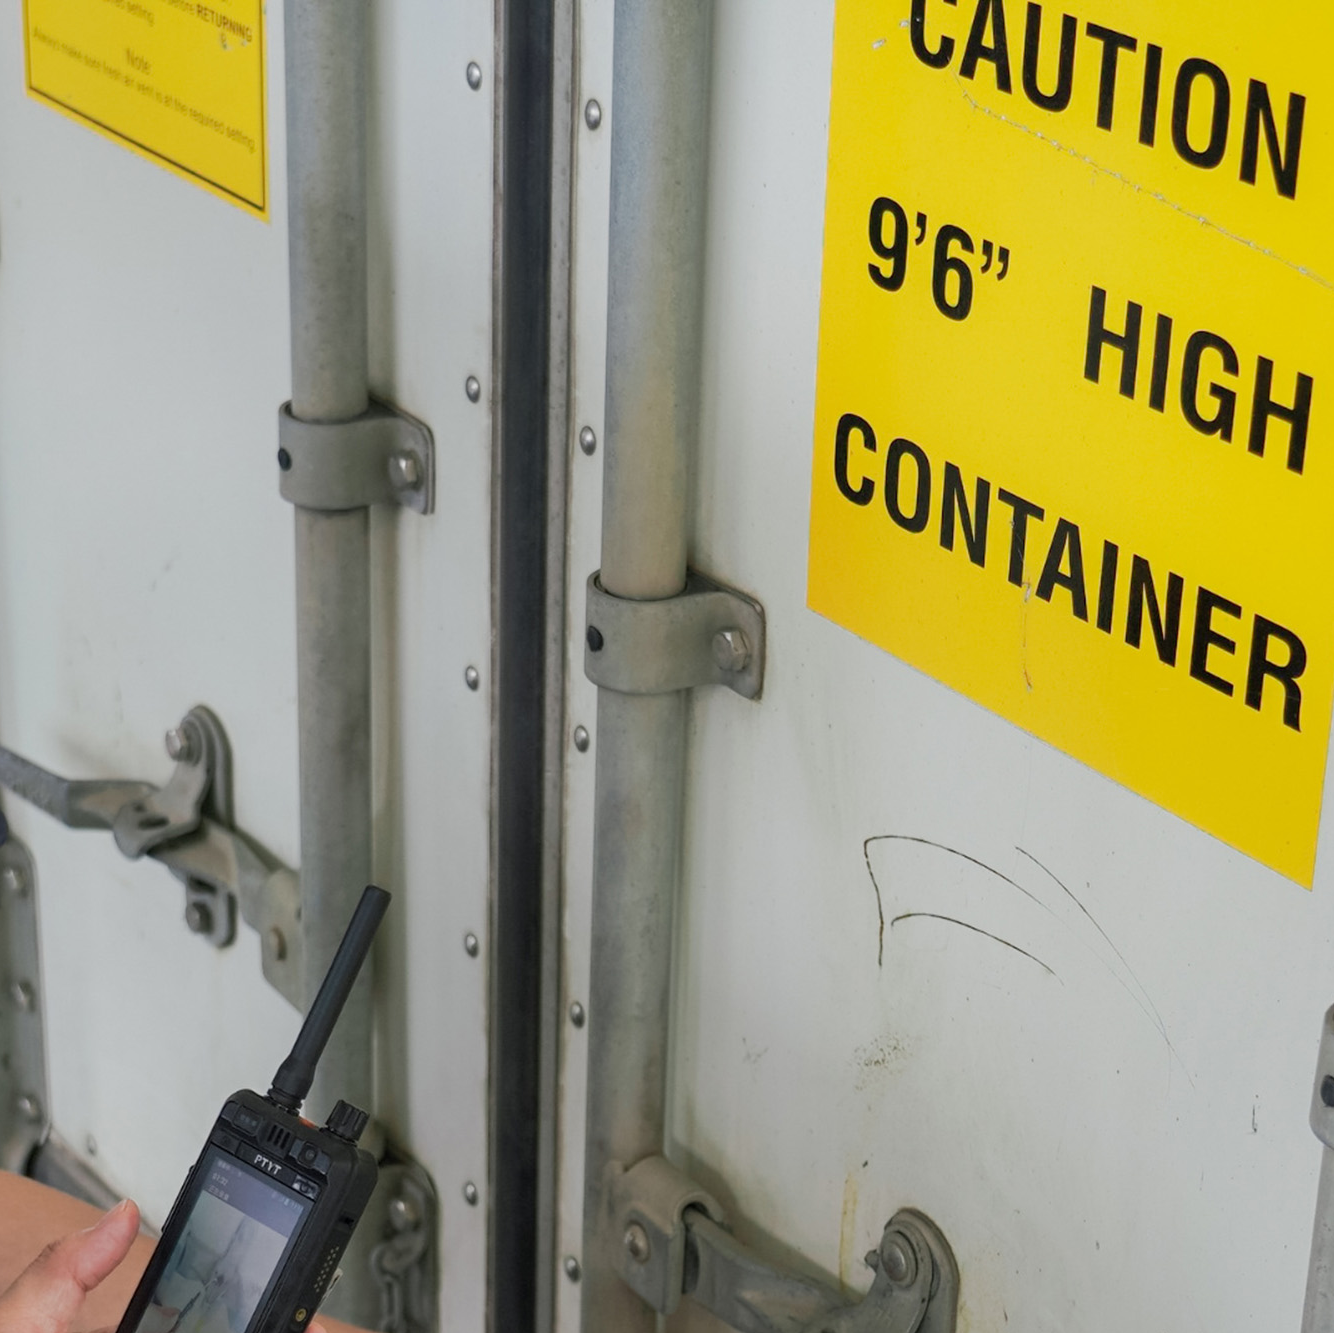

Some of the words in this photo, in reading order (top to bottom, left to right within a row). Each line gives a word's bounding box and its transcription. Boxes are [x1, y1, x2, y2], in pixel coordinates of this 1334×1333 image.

[907, 0, 1308, 200] CAUTION
[1084, 285, 1315, 476] HIGH
[833, 413, 1309, 733] CONTAINER
[253, 1154, 283, 1176] PTYT
